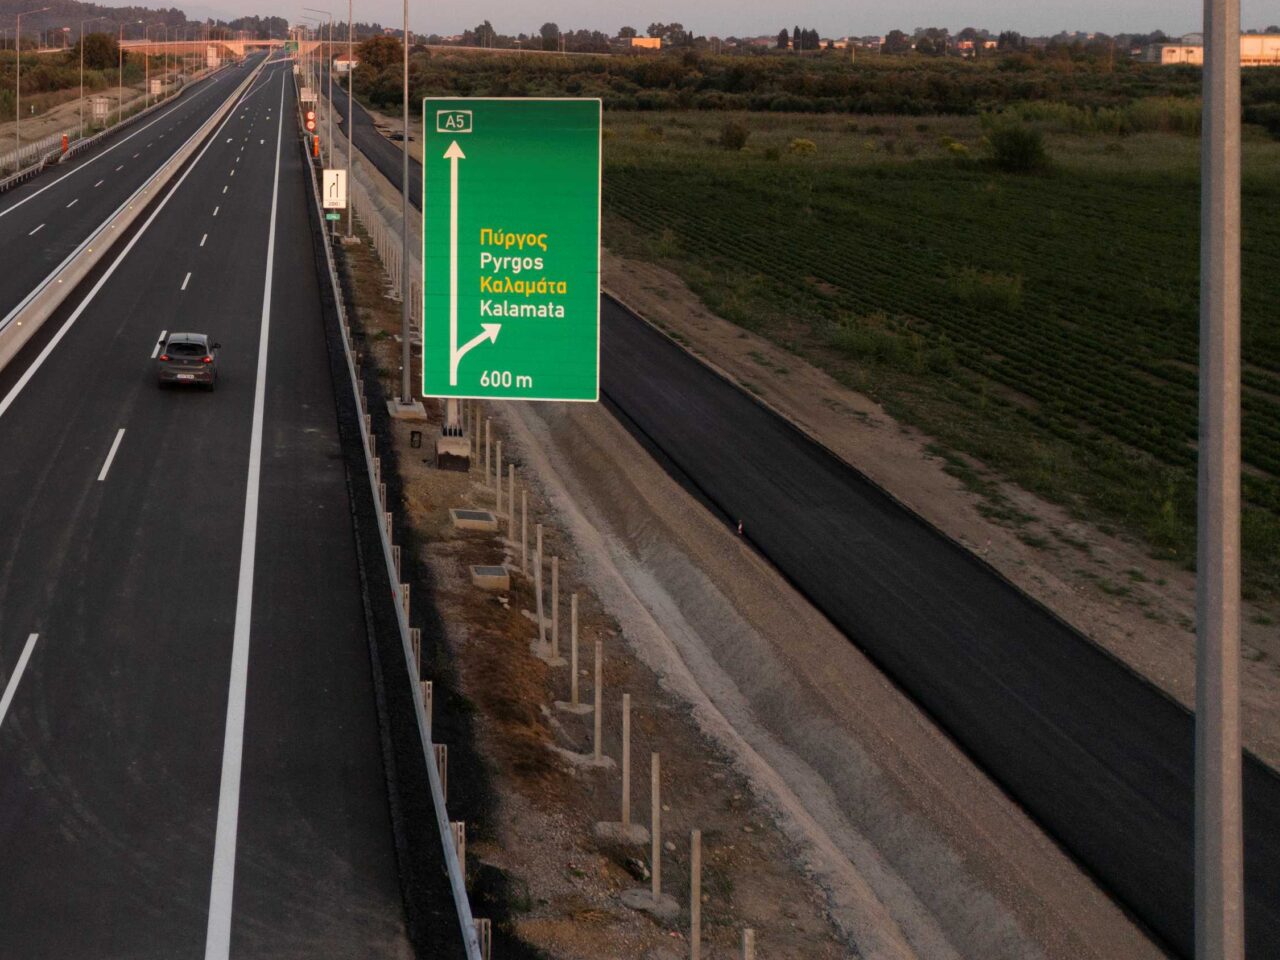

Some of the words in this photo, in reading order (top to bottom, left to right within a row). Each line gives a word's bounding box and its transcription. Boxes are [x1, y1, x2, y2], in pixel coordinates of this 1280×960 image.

[445, 114, 464, 128] A5
[480, 228, 547, 251] Πύργος
[480, 252, 543, 273] Pyrgos
[480, 276, 566, 297] Καλαμάτα
[480, 299, 564, 318] Kalamata
[480, 371, 512, 388] 600
[516, 375, 532, 388] m
